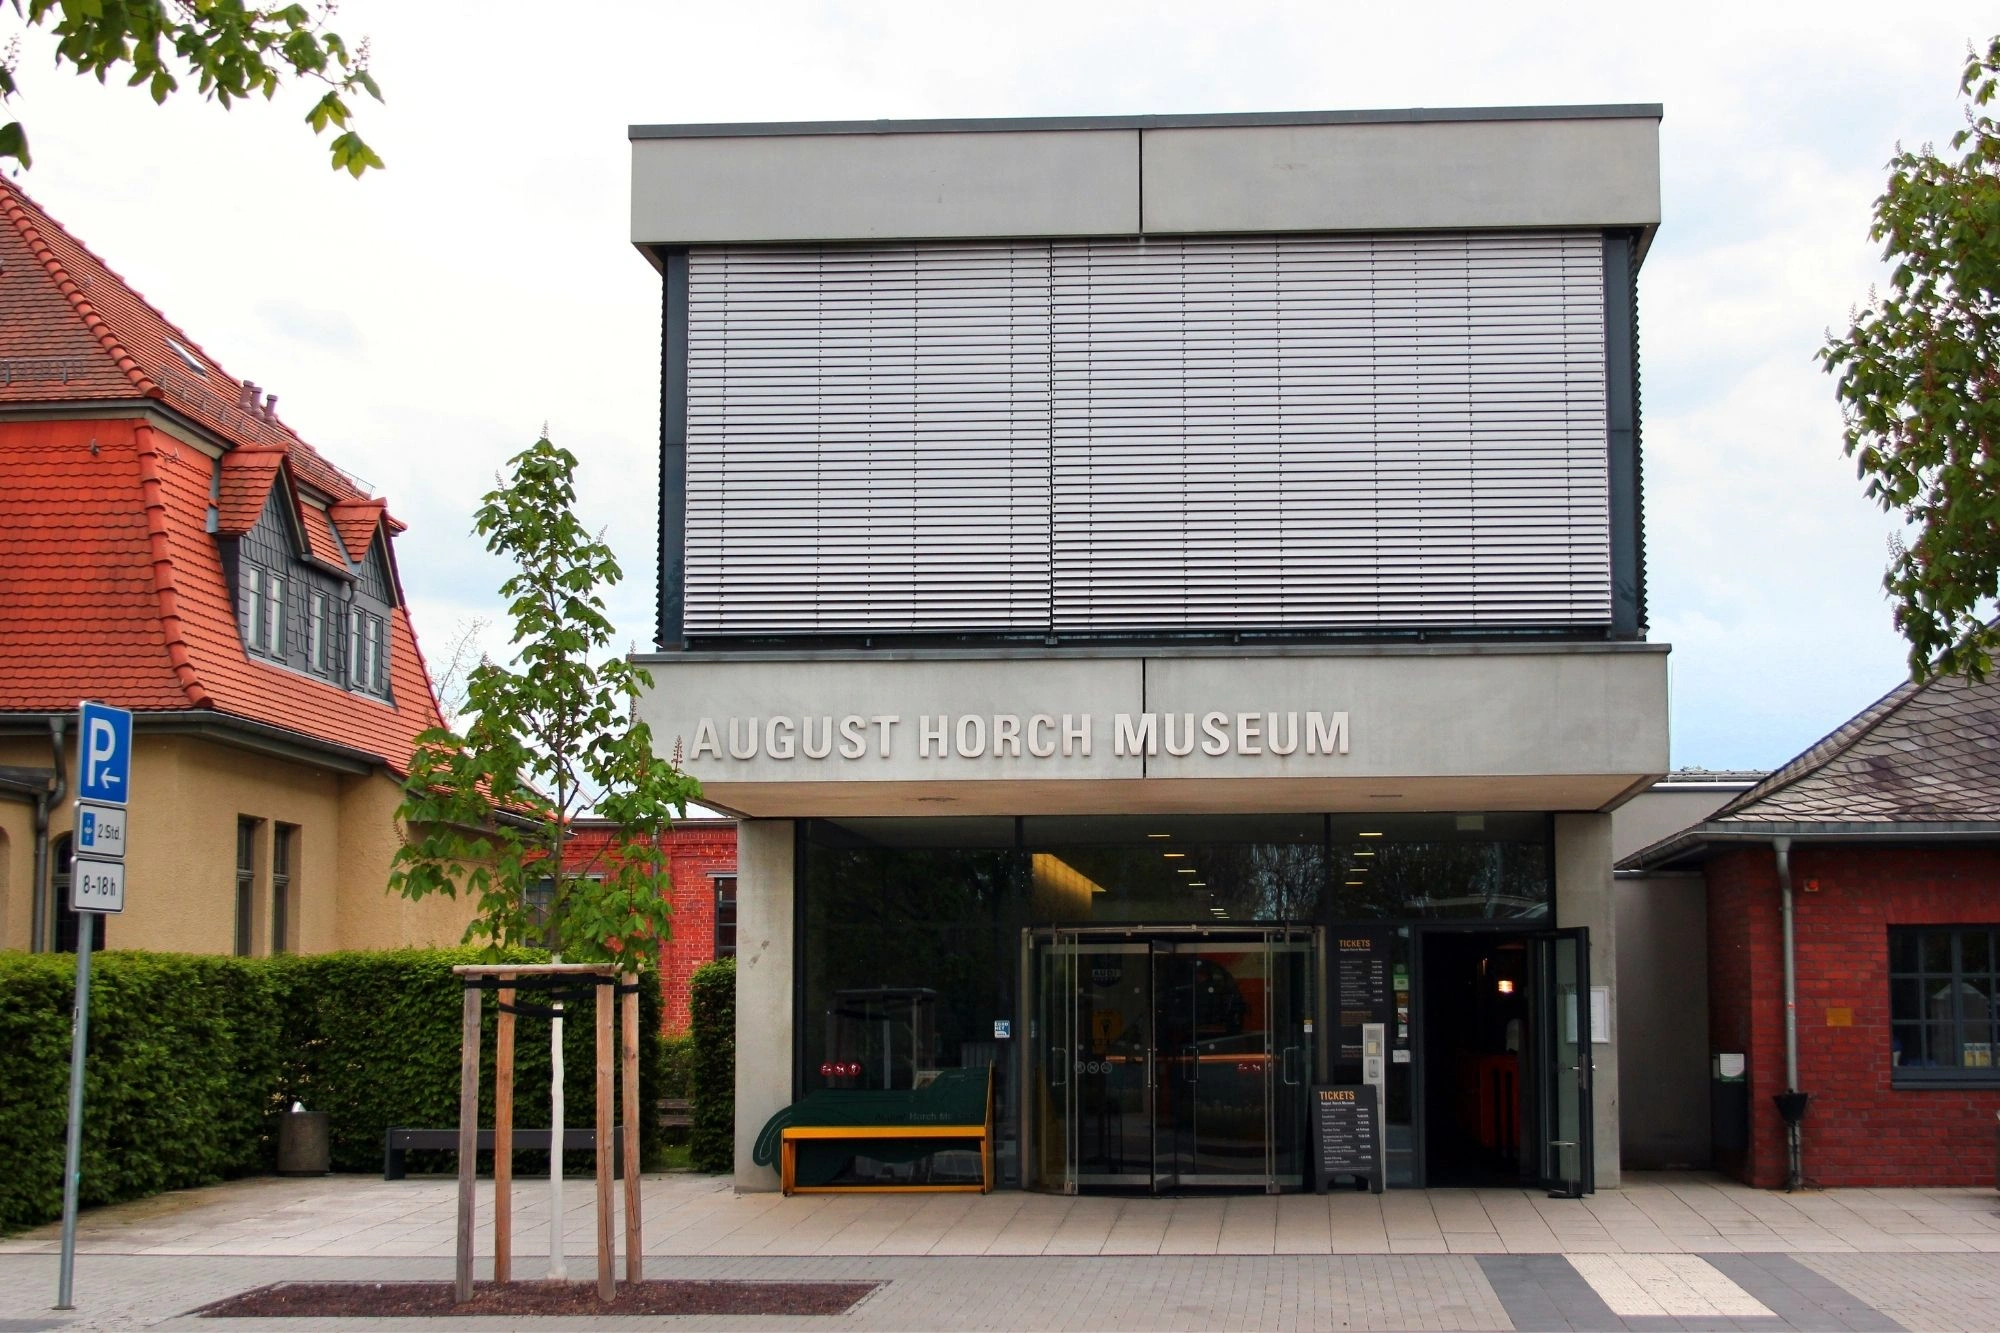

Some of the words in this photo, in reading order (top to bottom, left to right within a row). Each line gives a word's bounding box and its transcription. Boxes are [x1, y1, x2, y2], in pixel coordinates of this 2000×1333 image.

[690, 715, 900, 760] AUGUST
[919, 714, 1092, 759] HORCH
[1114, 711, 1349, 757] MUSEUM
[88, 718, 116, 787] P
[97, 823, 104, 838] 2
[1339, 939, 1371, 947] TICKETS
[1319, 1091, 1355, 1100] TICKETS
